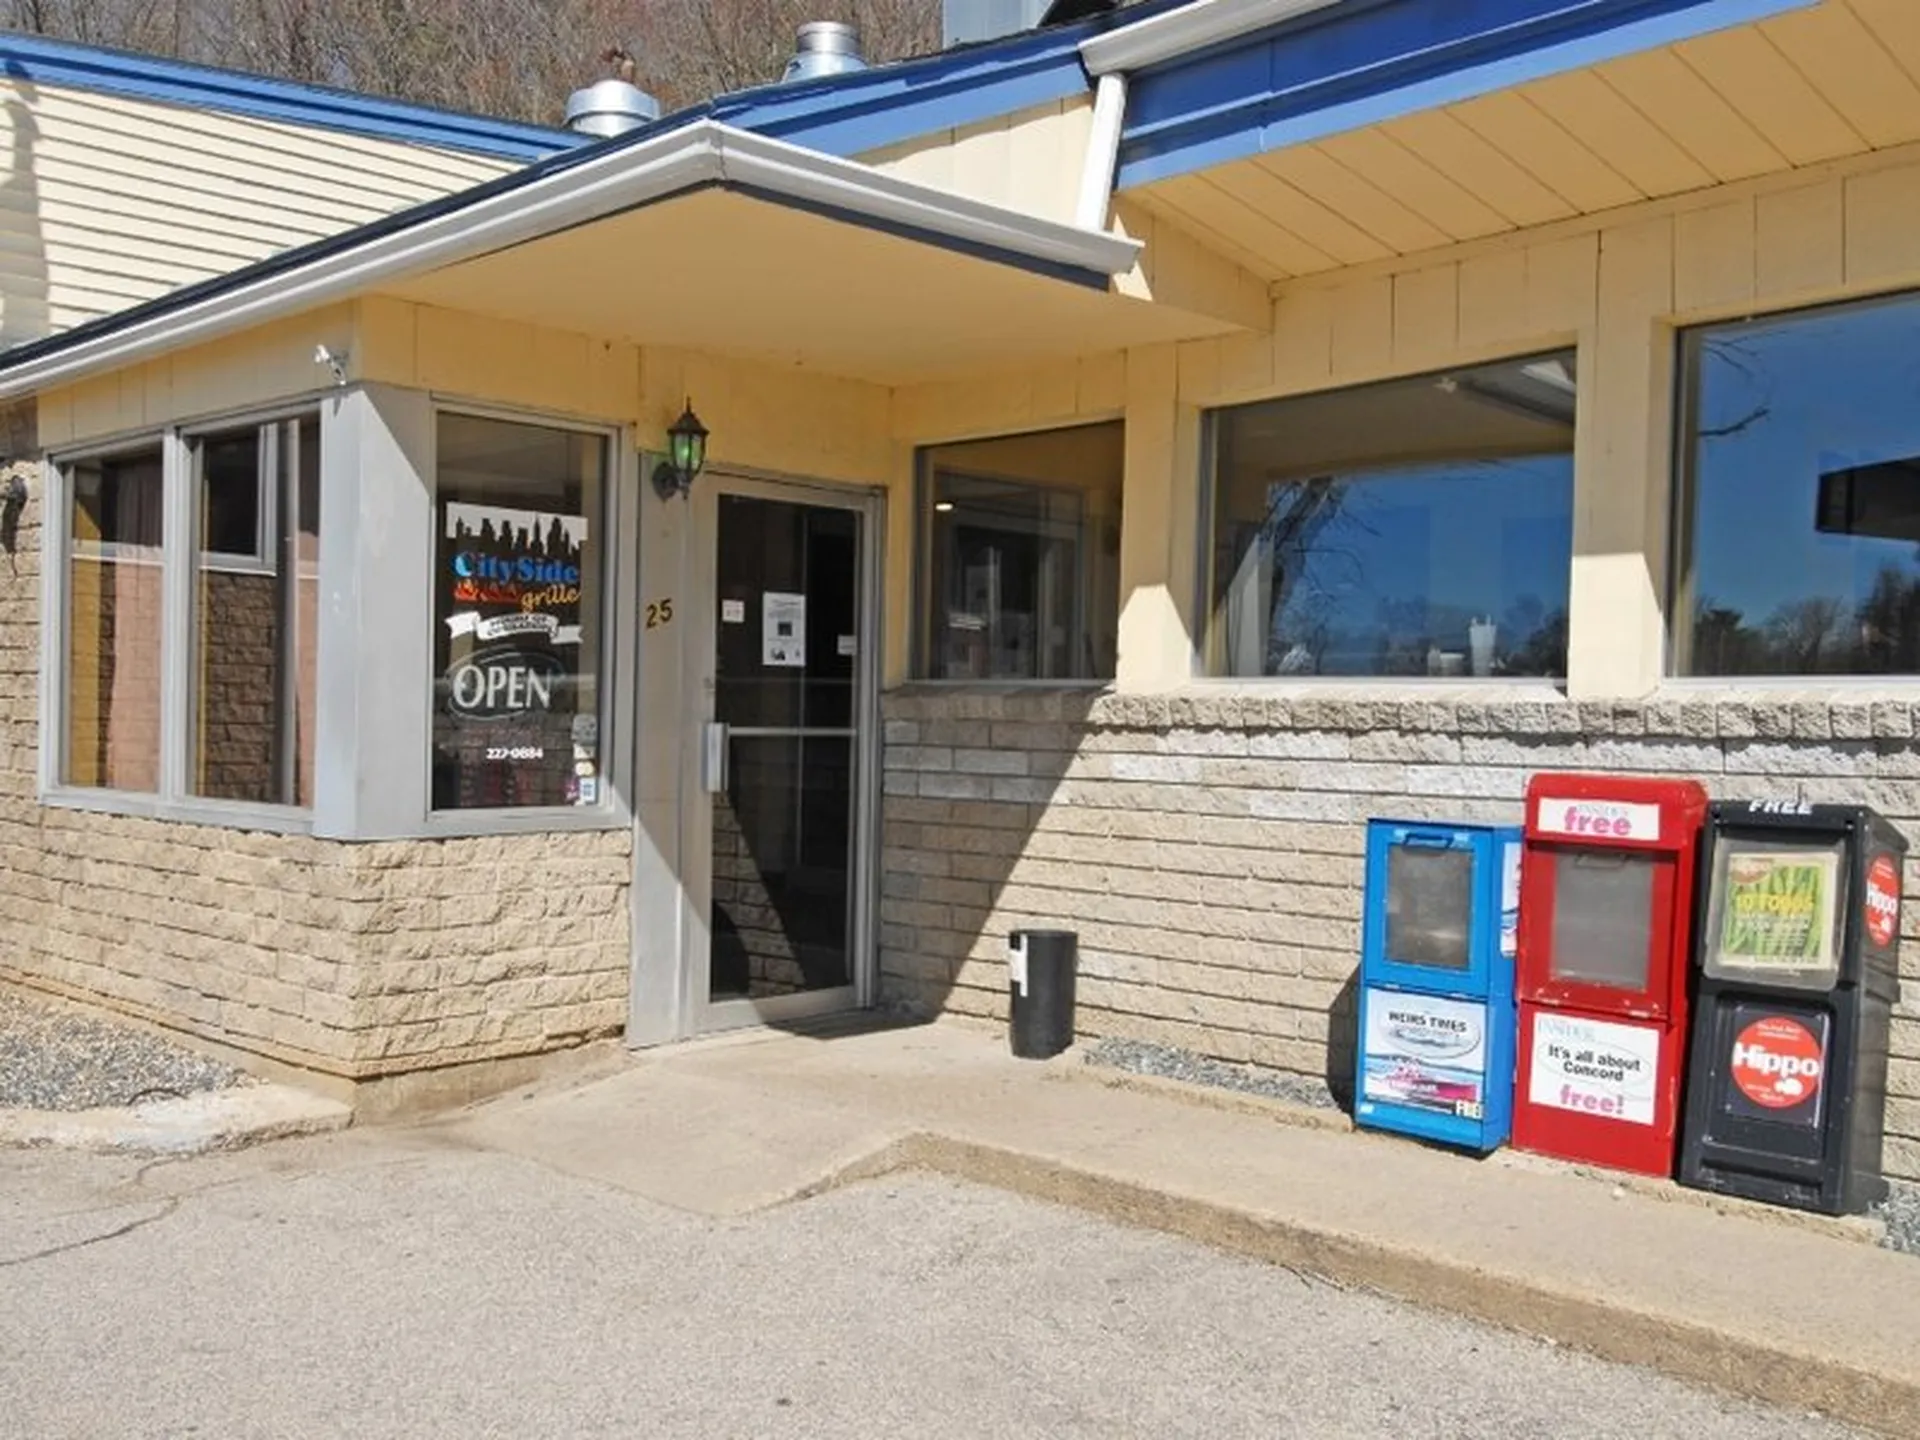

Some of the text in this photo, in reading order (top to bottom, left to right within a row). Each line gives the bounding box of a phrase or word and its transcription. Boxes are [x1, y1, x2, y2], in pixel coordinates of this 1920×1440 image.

[451, 552, 579, 584] CitySide
[520, 584, 581, 613] grille
[645, 598, 672, 629] 25
[453, 664, 551, 709] OPEN
[1564, 805, 1632, 836] free
[1749, 800, 1813, 816] FREE
[1548, 1043, 1641, 1072] It's all about
[1563, 1061, 1625, 1082] Concord
[1733, 1041, 1820, 1078] Hippo
[1560, 1083, 1625, 1115] free!
